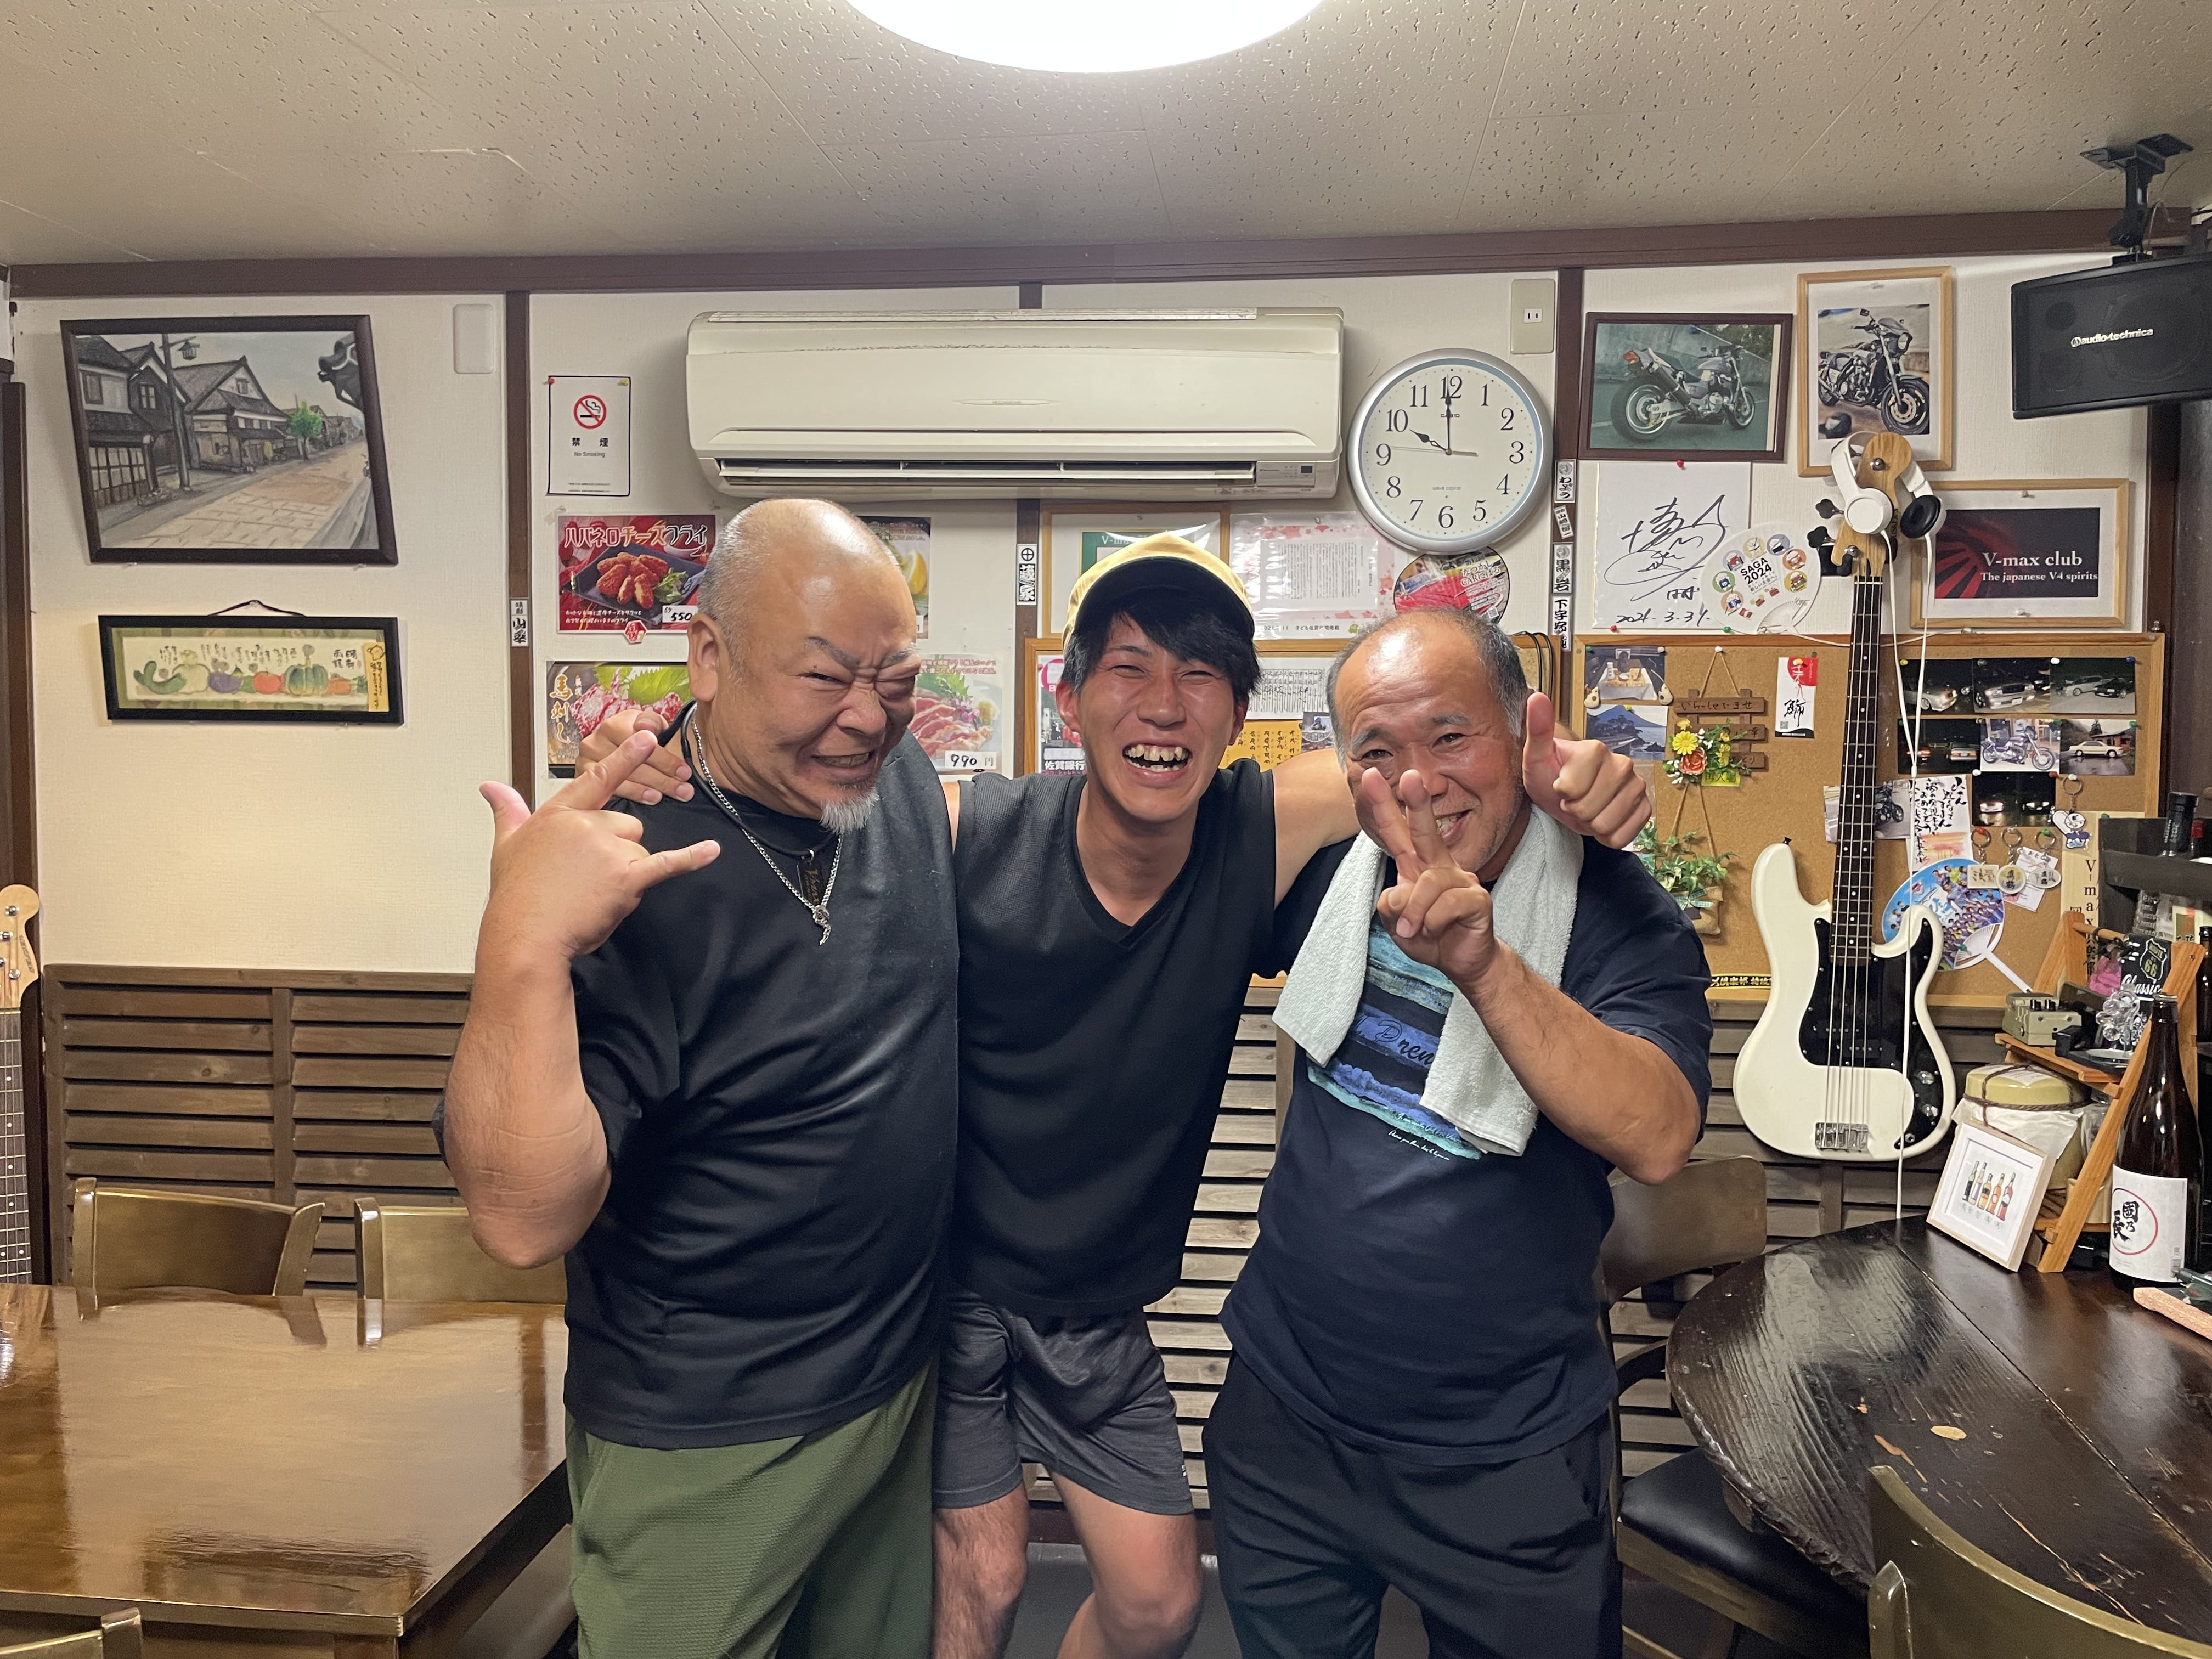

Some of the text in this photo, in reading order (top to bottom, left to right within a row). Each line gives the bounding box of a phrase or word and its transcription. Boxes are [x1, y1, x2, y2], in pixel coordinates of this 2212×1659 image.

[2081, 329, 2153, 345] audio-technica
[1409, 385, 1429, 407] 11
[1440, 376, 1463, 399] 12
[1481, 384, 1489, 407] 1
[1386, 409, 1409, 432] 10
[1500, 408, 1514, 431] 2
[1376, 443, 1391, 466] 9
[1509, 441, 1524, 464] 3
[1386, 476, 1401, 498] 8
[1496, 473, 1510, 495] 4
[1409, 500, 1423, 521] 7
[1438, 506, 1454, 529] 6
[1472, 500, 1486, 522] 5
[564, 524, 708, 548] ハバネロチーズフライ
[1740, 557, 1768, 576] SAGA
[1982, 550, 2083, 567] V-max club
[1744, 563, 1772, 585] 2024
[1980, 571, 2098, 583] The japanese V4 spirits
[670, 612, 692, 622] 550
[951, 754, 977, 767] 990
[1045, 760, 1085, 770] 佐賀銀行
[2144, 960, 2158, 978] 66
